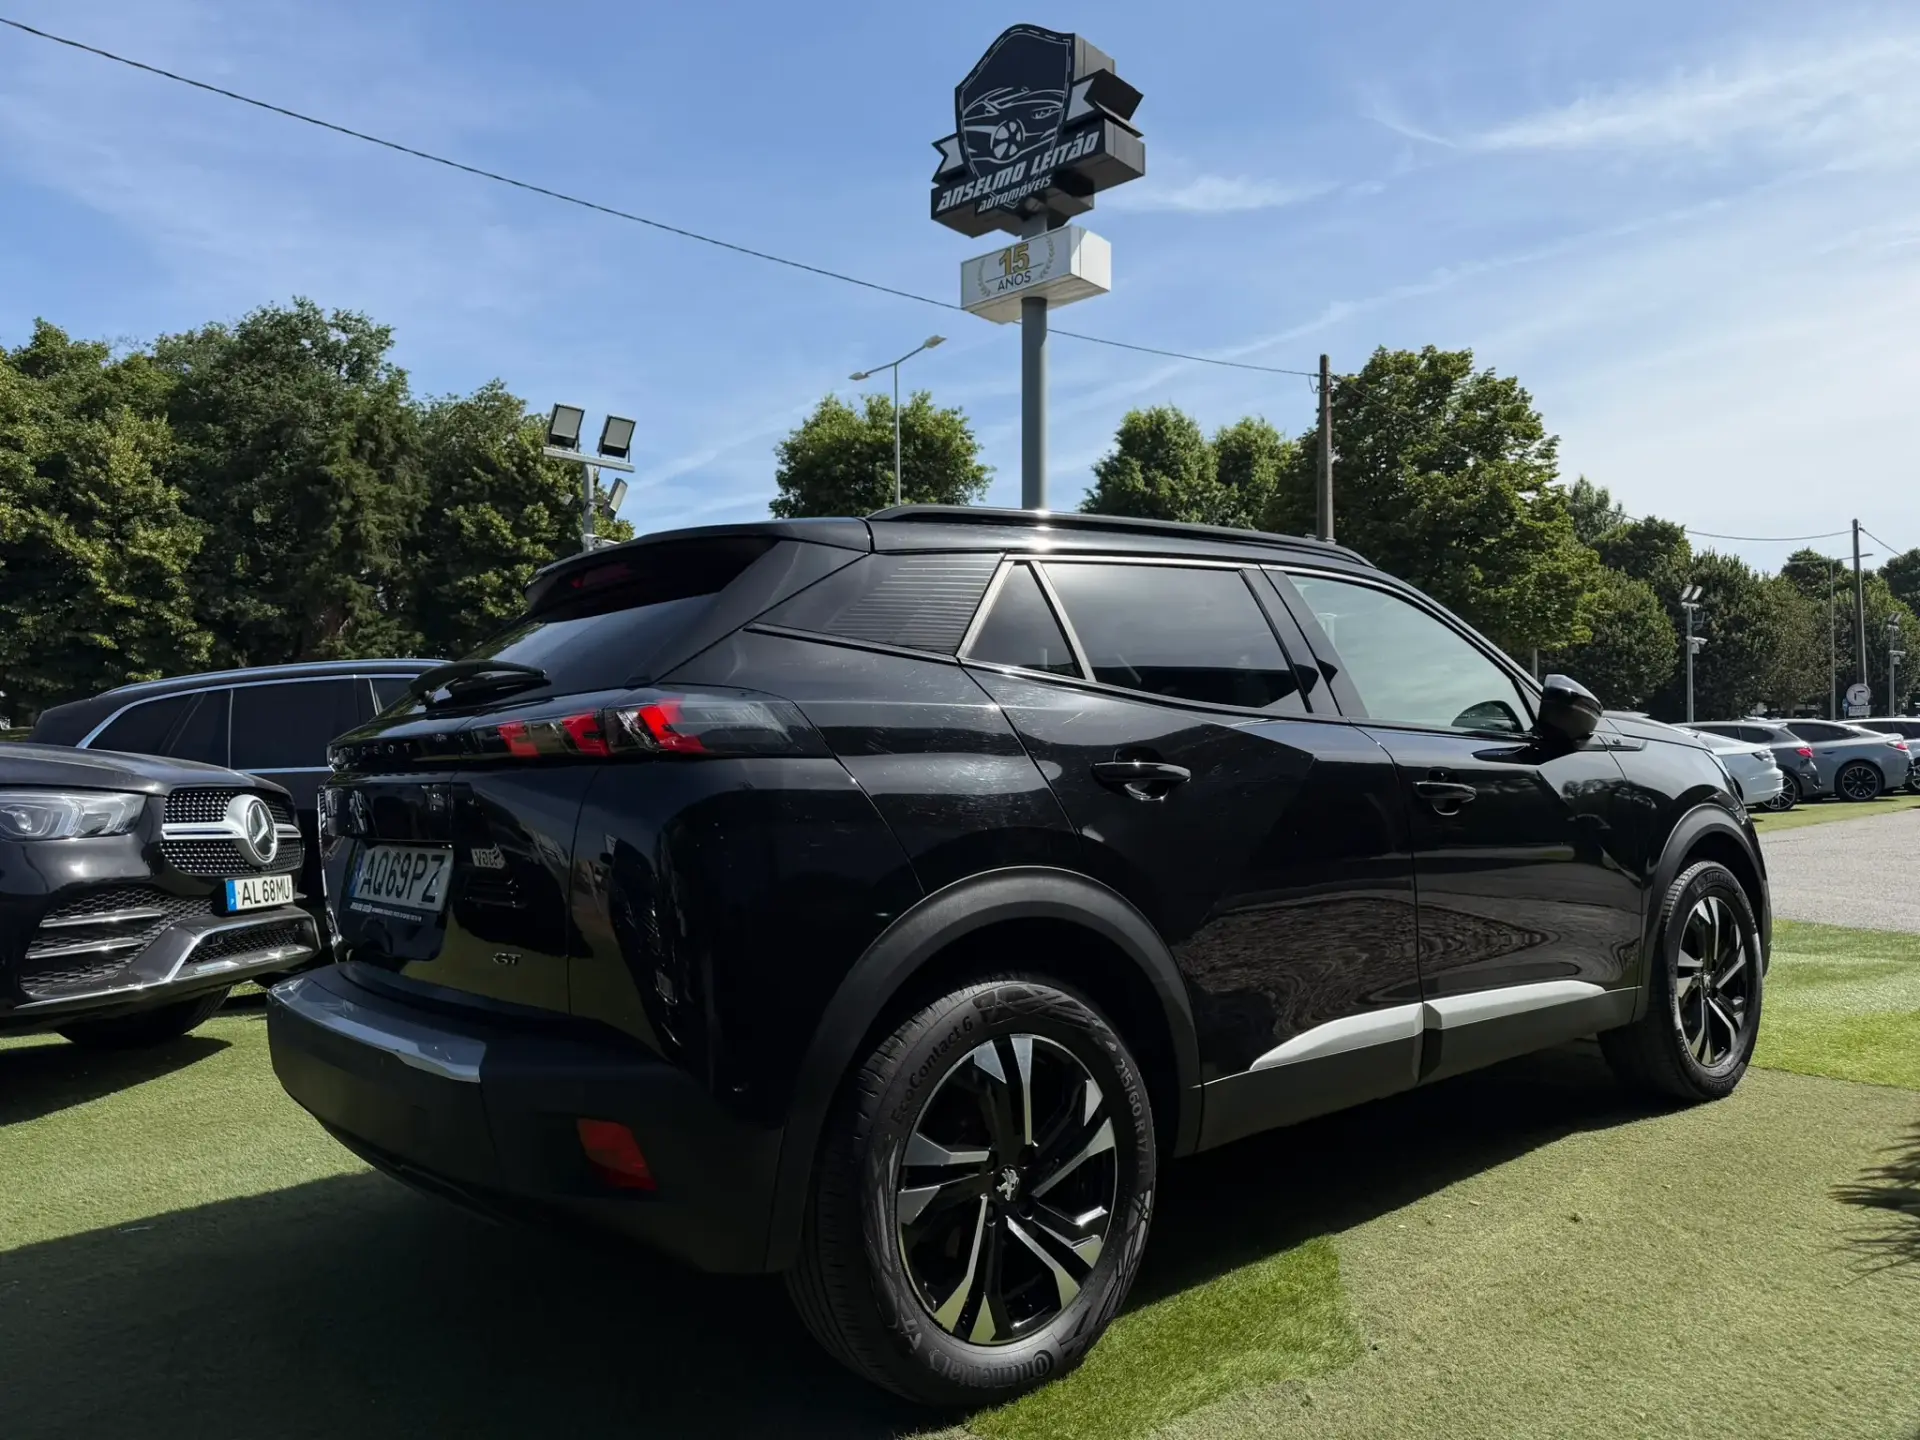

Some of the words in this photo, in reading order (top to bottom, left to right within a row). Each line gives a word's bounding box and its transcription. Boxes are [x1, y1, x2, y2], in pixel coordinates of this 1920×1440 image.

[936, 161, 1028, 212] ANSELMO
[1031, 131, 1100, 175] LEITÃO
[999, 243, 1030, 277] 15
[997, 270, 1031, 293] ANOS
[359, 852, 446, 903] AQ69PZ
[492, 951, 522, 966] GT
